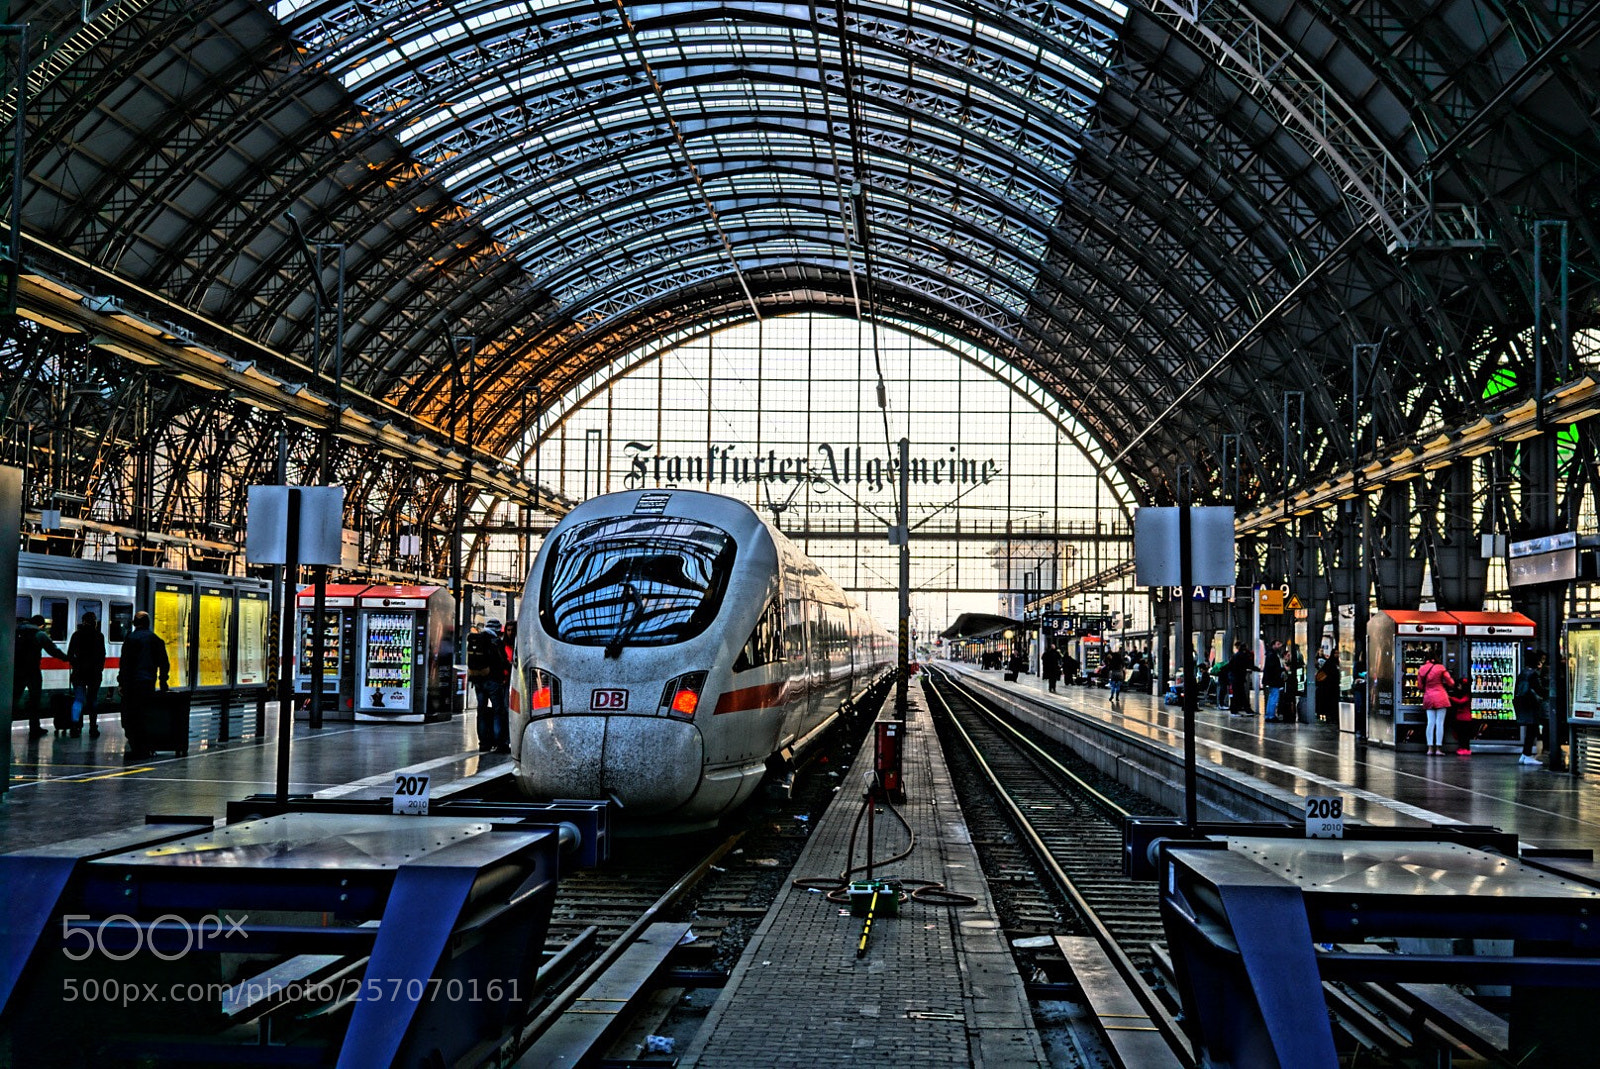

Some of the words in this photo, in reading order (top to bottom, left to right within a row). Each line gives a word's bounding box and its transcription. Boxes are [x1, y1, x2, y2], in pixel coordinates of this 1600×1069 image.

[624, 441, 808, 489] Frankfurter
[811, 442, 996, 494] Allgemeine
[809, 500, 957, 514] DEUSCHAND
[1192, 585, 1205, 598] A
[594, 690, 625, 708] DB
[395, 776, 429, 796] 207
[408, 800, 428, 809] 2010
[1307, 799, 1342, 819] 208
[1321, 823, 1342, 832] 2010
